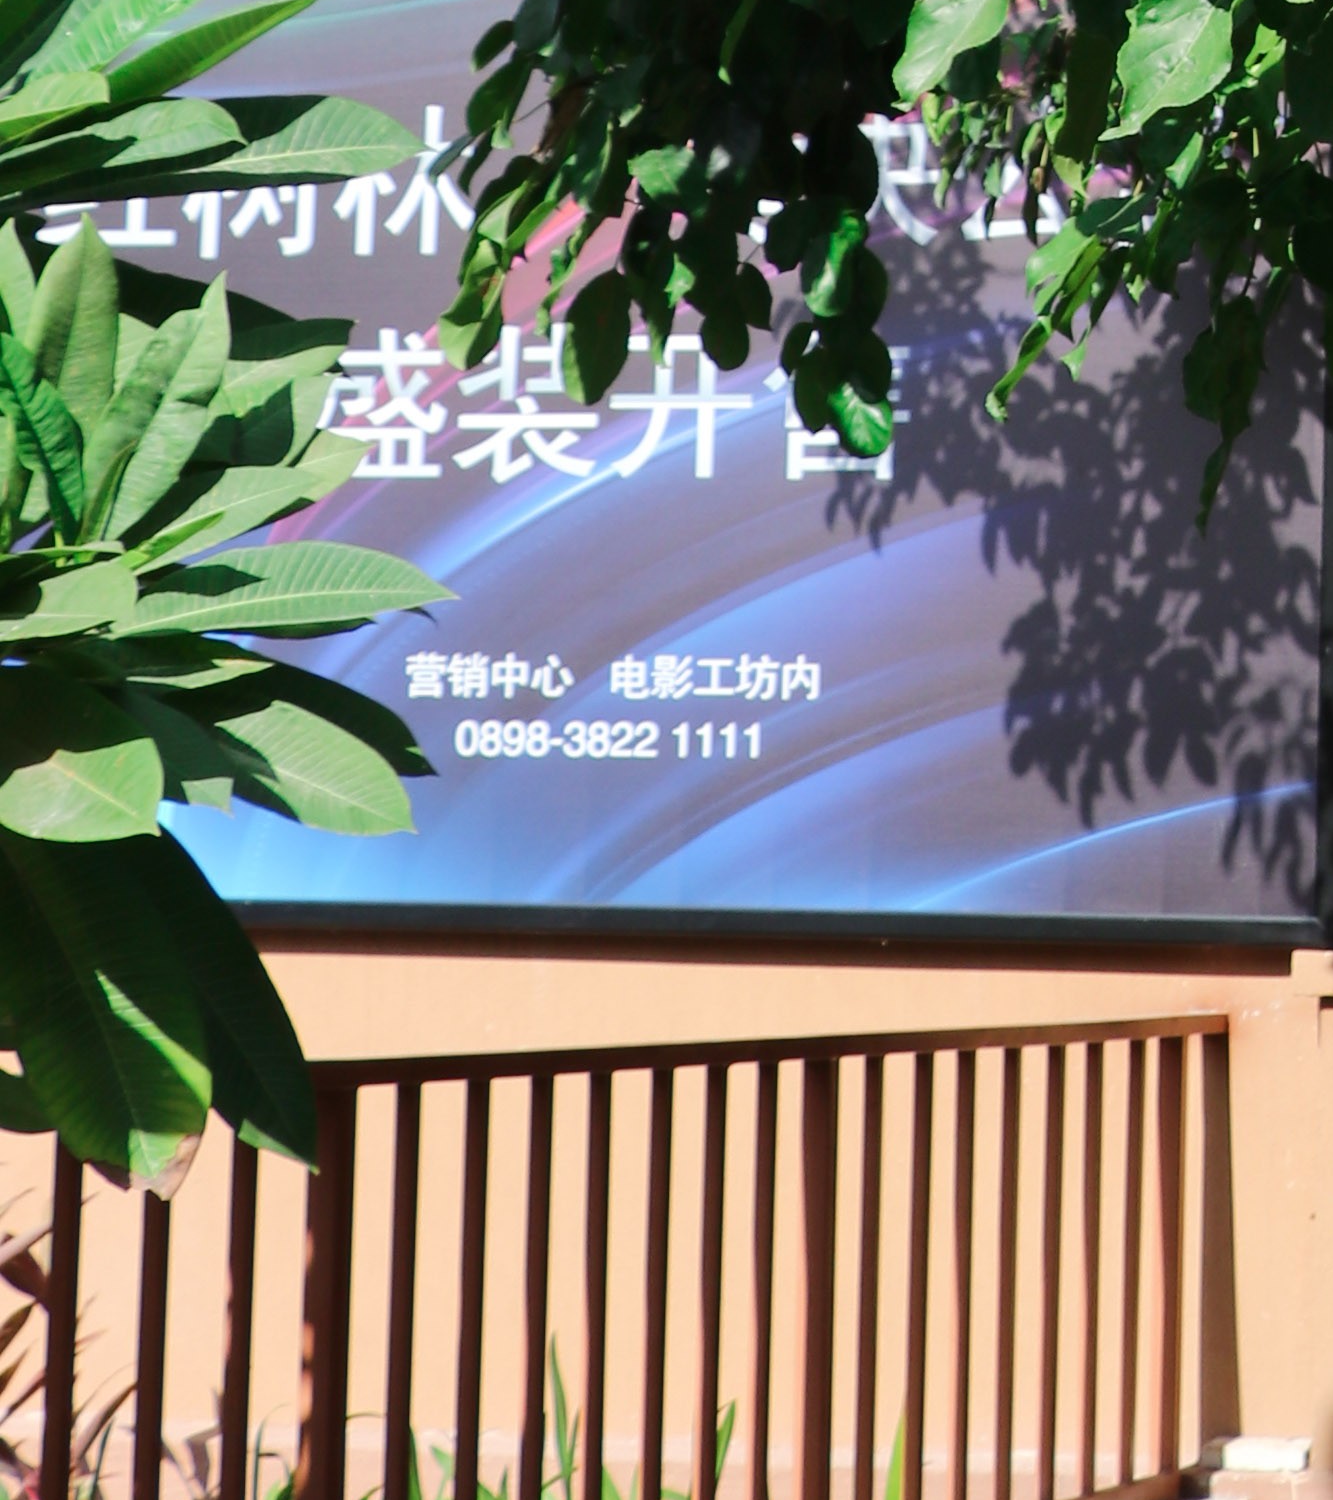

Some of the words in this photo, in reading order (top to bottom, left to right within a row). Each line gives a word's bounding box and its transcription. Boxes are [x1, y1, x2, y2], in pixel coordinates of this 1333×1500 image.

[405, 651, 574, 699] 营销中心
[610, 653, 821, 700] 电影工坊内
[455, 720, 659, 758] 0898-3822
[672, 722, 761, 759] 1111
